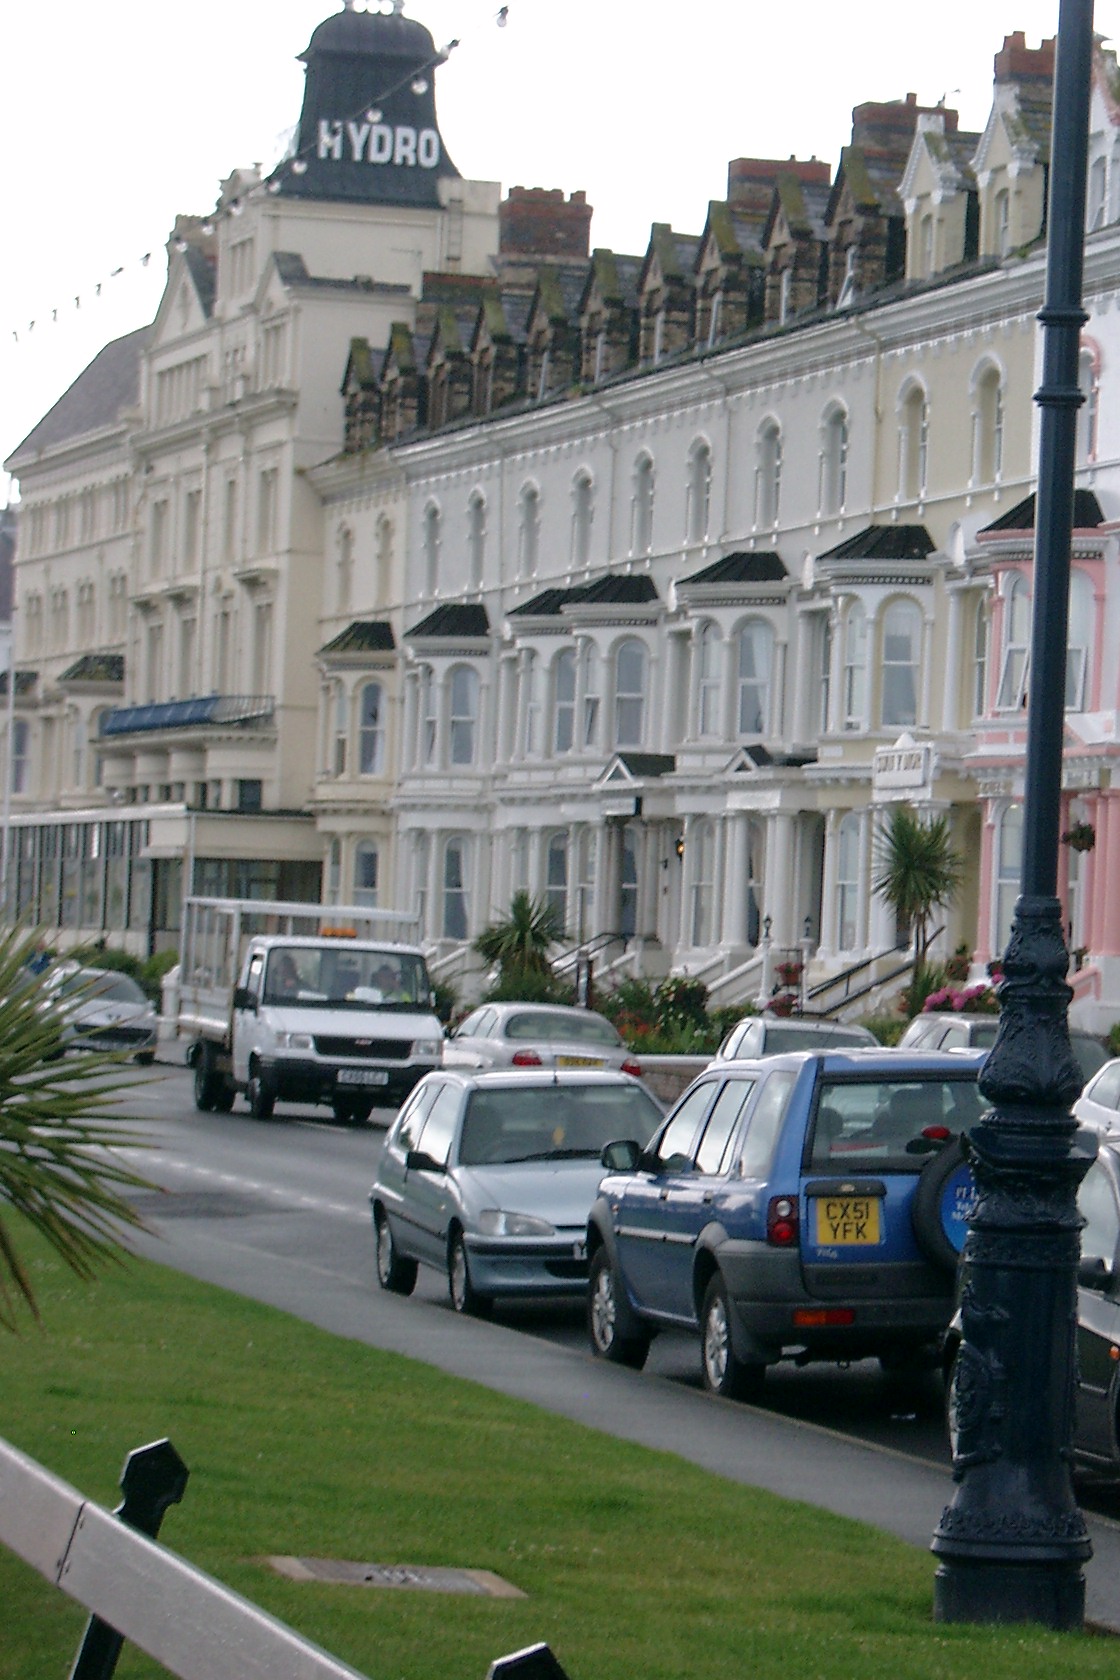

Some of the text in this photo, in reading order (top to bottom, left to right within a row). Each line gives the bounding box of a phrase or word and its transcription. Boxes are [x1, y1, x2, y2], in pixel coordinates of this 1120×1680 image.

[317, 119, 441, 169] HYDRO
[825, 1202, 869, 1221] CX51
[830, 1222, 867, 1240] YFK
